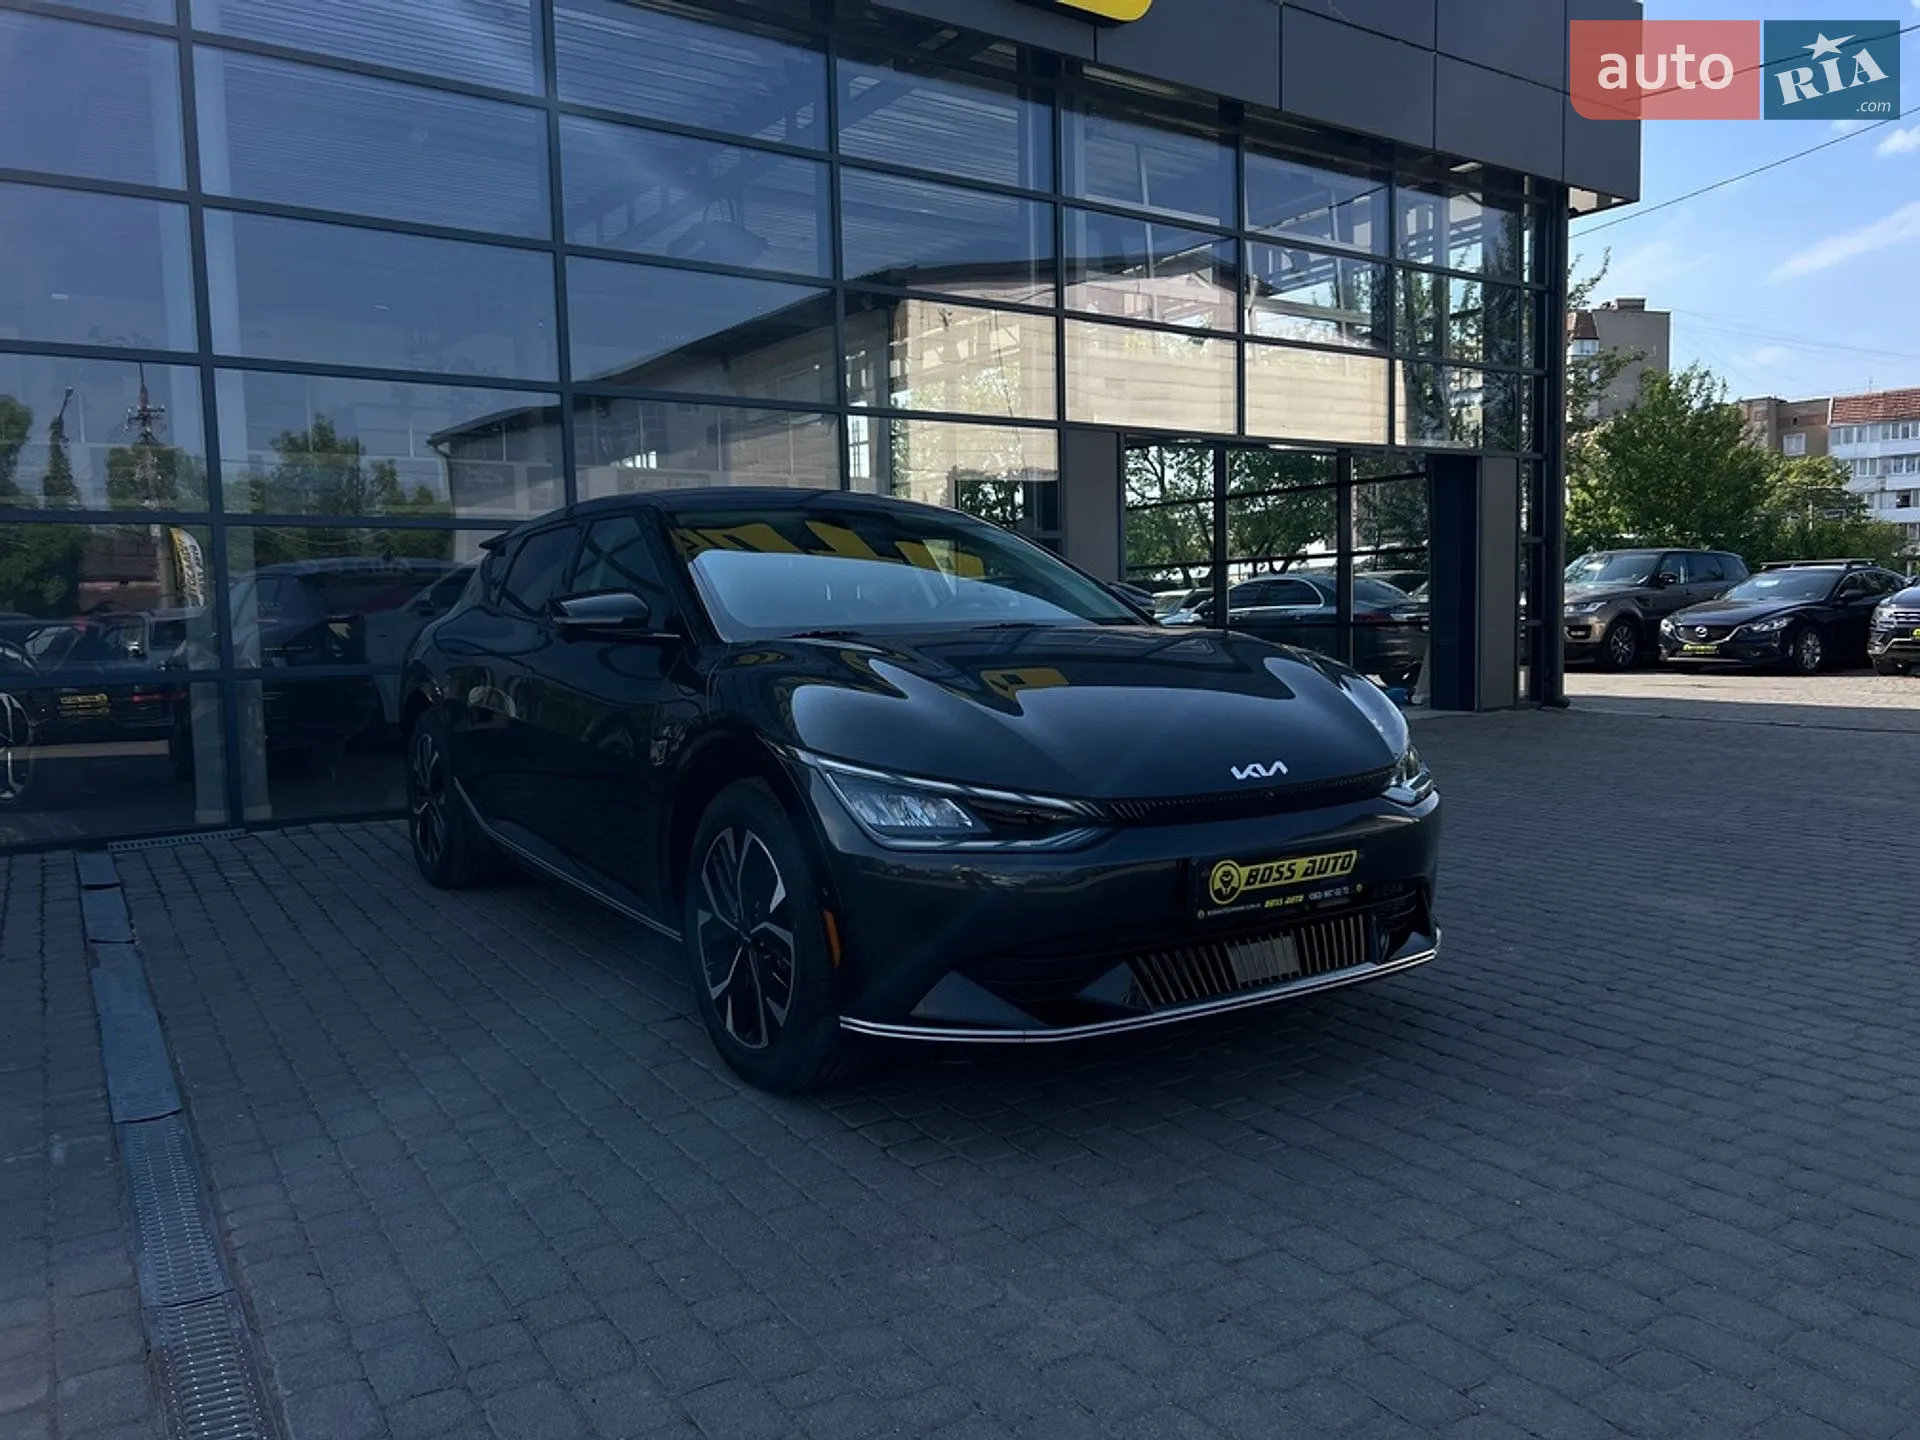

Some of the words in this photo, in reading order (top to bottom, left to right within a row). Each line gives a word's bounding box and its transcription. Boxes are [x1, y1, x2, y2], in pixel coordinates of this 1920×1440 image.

[1230, 761, 1288, 779] KIA
[1245, 862, 1297, 886] BOSS
[1303, 852, 1354, 876] AUTO
